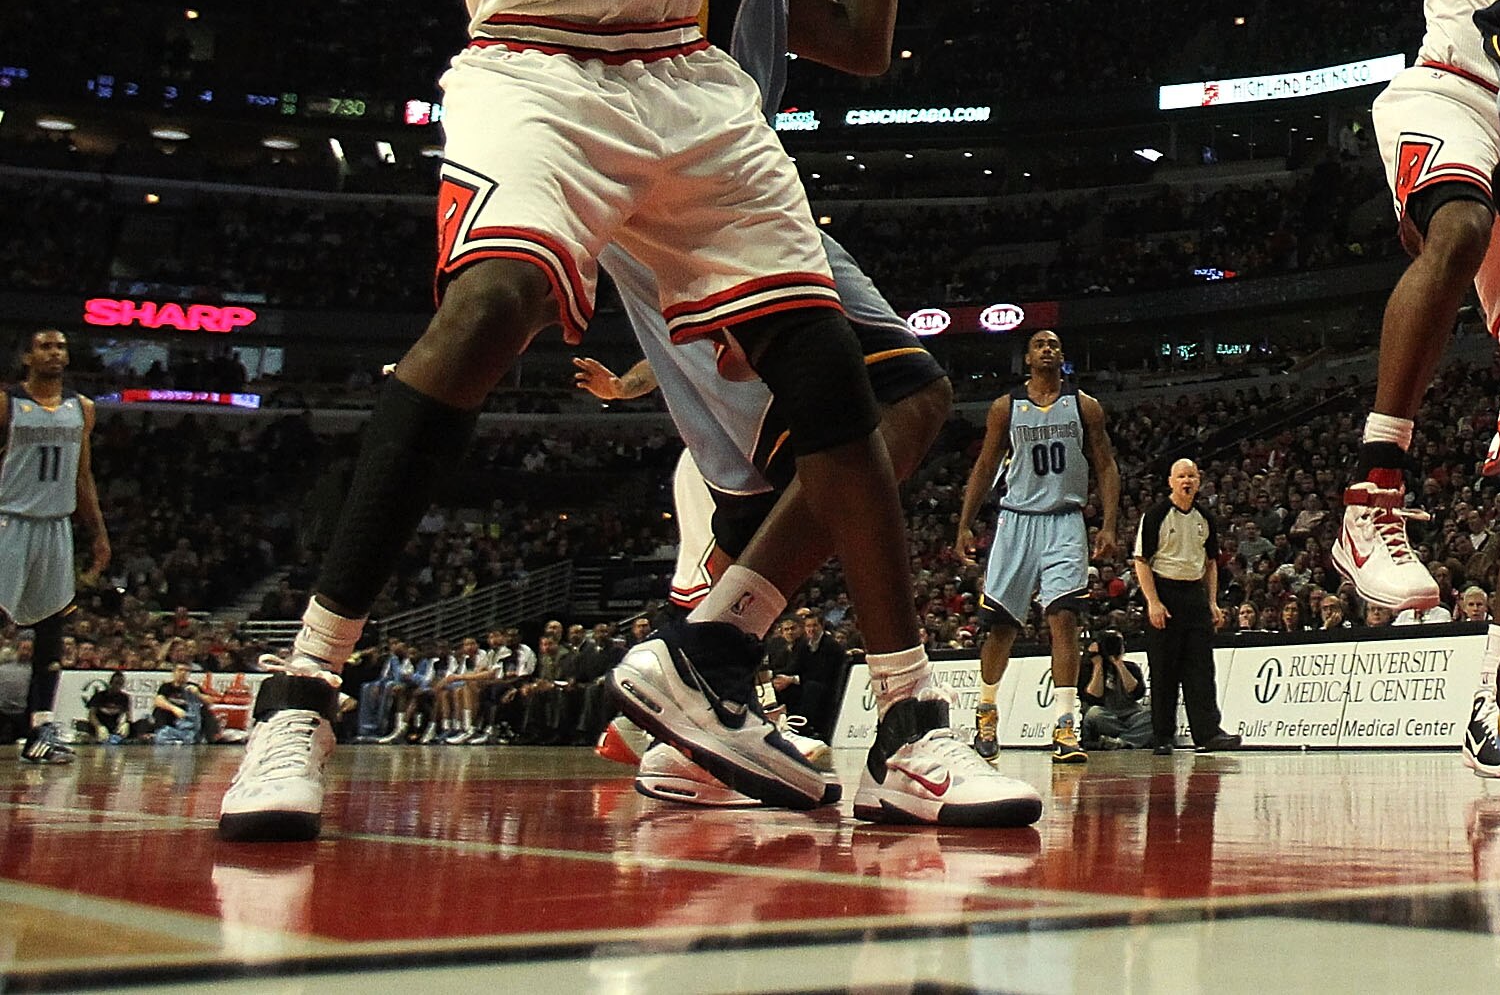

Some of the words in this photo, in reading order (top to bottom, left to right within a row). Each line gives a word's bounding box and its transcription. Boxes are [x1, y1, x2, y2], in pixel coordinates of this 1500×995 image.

[1232, 77, 1301, 99] HIGHLAND
[845, 106, 991, 125] CSNCHICAGO.COM
[85, 298, 257, 333] SHARP
[39, 445, 62, 482] 11
[1032, 441, 1066, 476] 00
[1289, 654, 1338, 677] RUSH
[1341, 649, 1455, 676] UNIVERSITY
[1284, 680, 1364, 704] MEDICAL
[1370, 677, 1446, 702] CENTER
[1020, 723, 1050, 739] Bulls'
[1275, 718, 1340, 737] Preferred
[1343, 718, 1401, 737] Medical
[1405, 718, 1456, 736] Center
